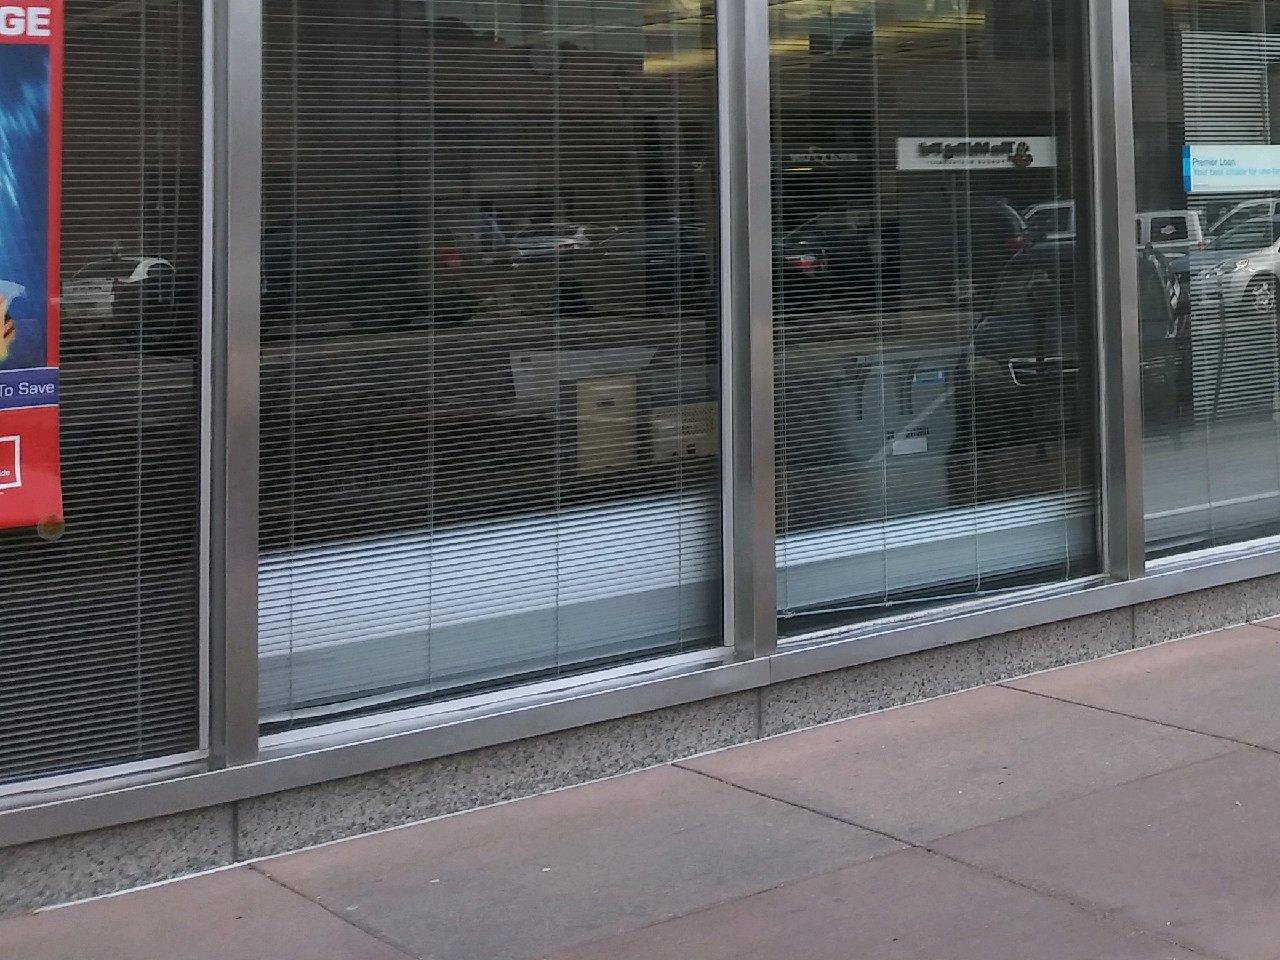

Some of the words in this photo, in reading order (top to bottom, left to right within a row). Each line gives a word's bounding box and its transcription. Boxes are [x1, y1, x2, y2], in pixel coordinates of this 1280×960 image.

[0, 5, 51, 37] GE
[1192, 157, 1217, 167] Premier
[18, 381, 55, 396] Save
